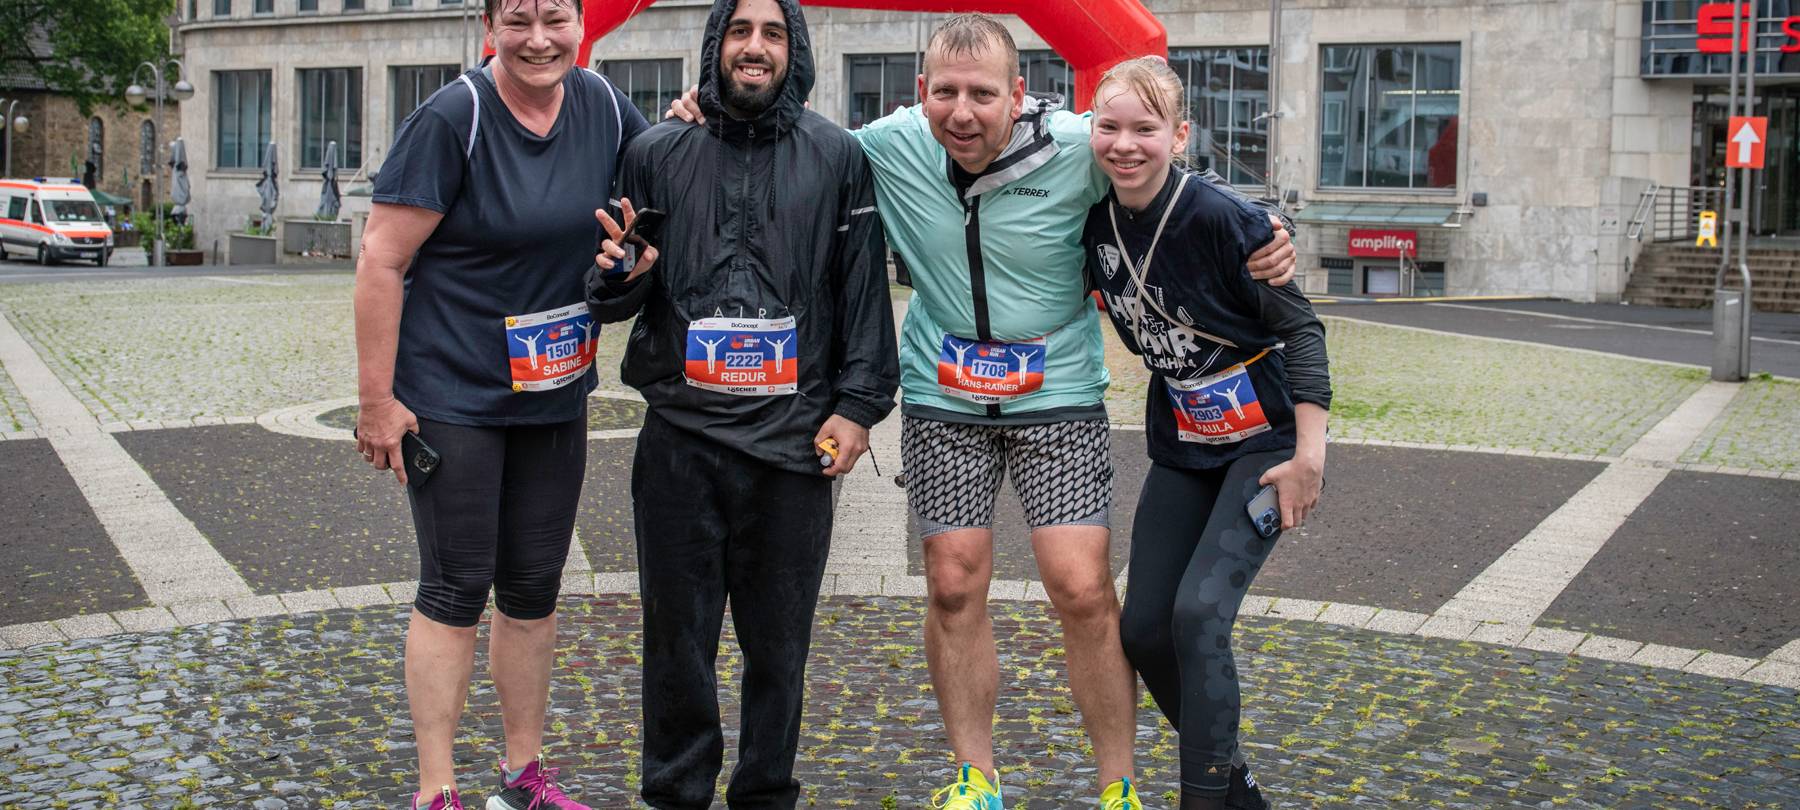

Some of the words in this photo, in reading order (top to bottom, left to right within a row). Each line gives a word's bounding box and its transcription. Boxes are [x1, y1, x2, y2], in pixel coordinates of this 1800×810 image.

[1013, 187, 1050, 198] TERREX
[1351, 235, 1414, 252] amplifon
[547, 340, 577, 360] 1501
[543, 355, 582, 376] SABINE
[726, 354, 762, 367] 2222
[973, 360, 1006, 378] 1708
[720, 371, 767, 382] REDUR
[957, 378, 1019, 391] HANS-RAINER
[1190, 409, 1223, 421] 2903
[1195, 422, 1234, 433] PAULA
